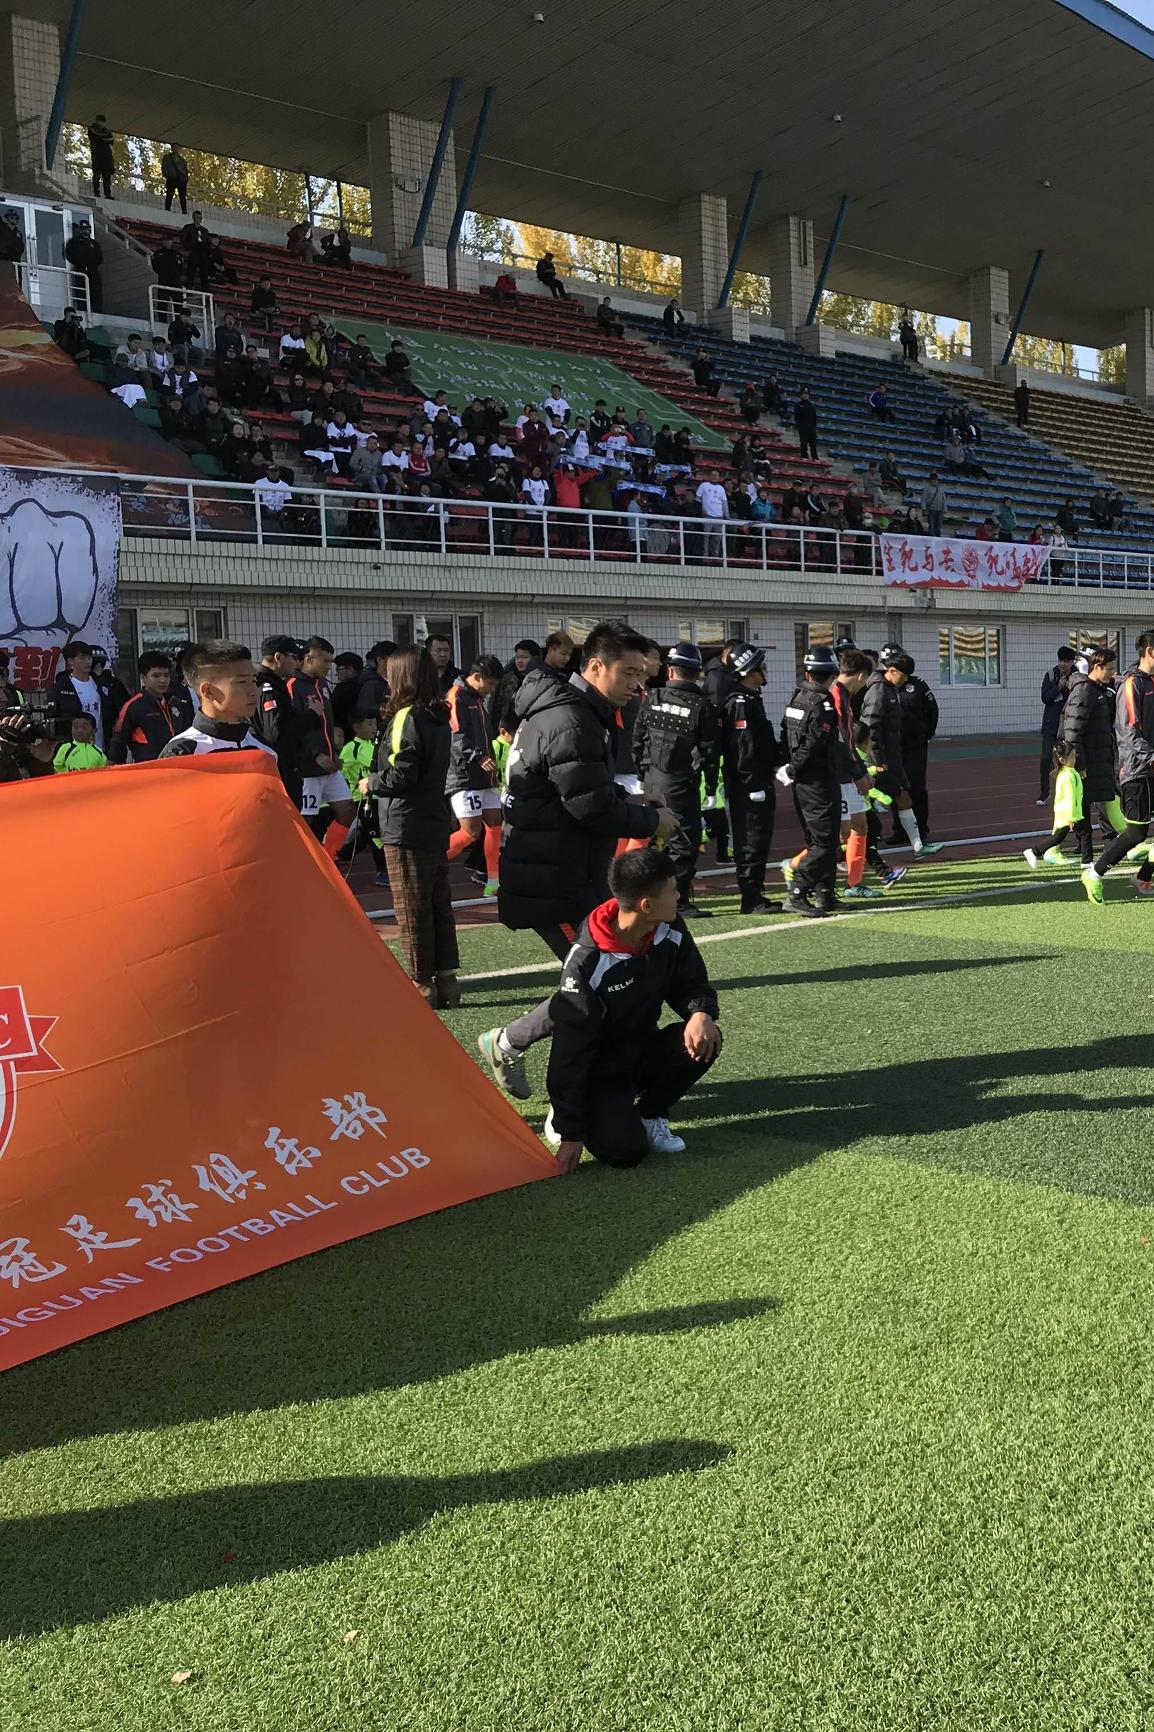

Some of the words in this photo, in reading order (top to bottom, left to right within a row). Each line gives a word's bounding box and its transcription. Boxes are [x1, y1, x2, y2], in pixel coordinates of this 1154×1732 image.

[302, 794, 317, 809] 12
[467, 795, 482, 811] 15
[0, 1091, 388, 1289] 冠足球俱乐部
[145, 1194, 338, 1273] FOOTBALL
[340, 1146, 432, 1196] CLUB
